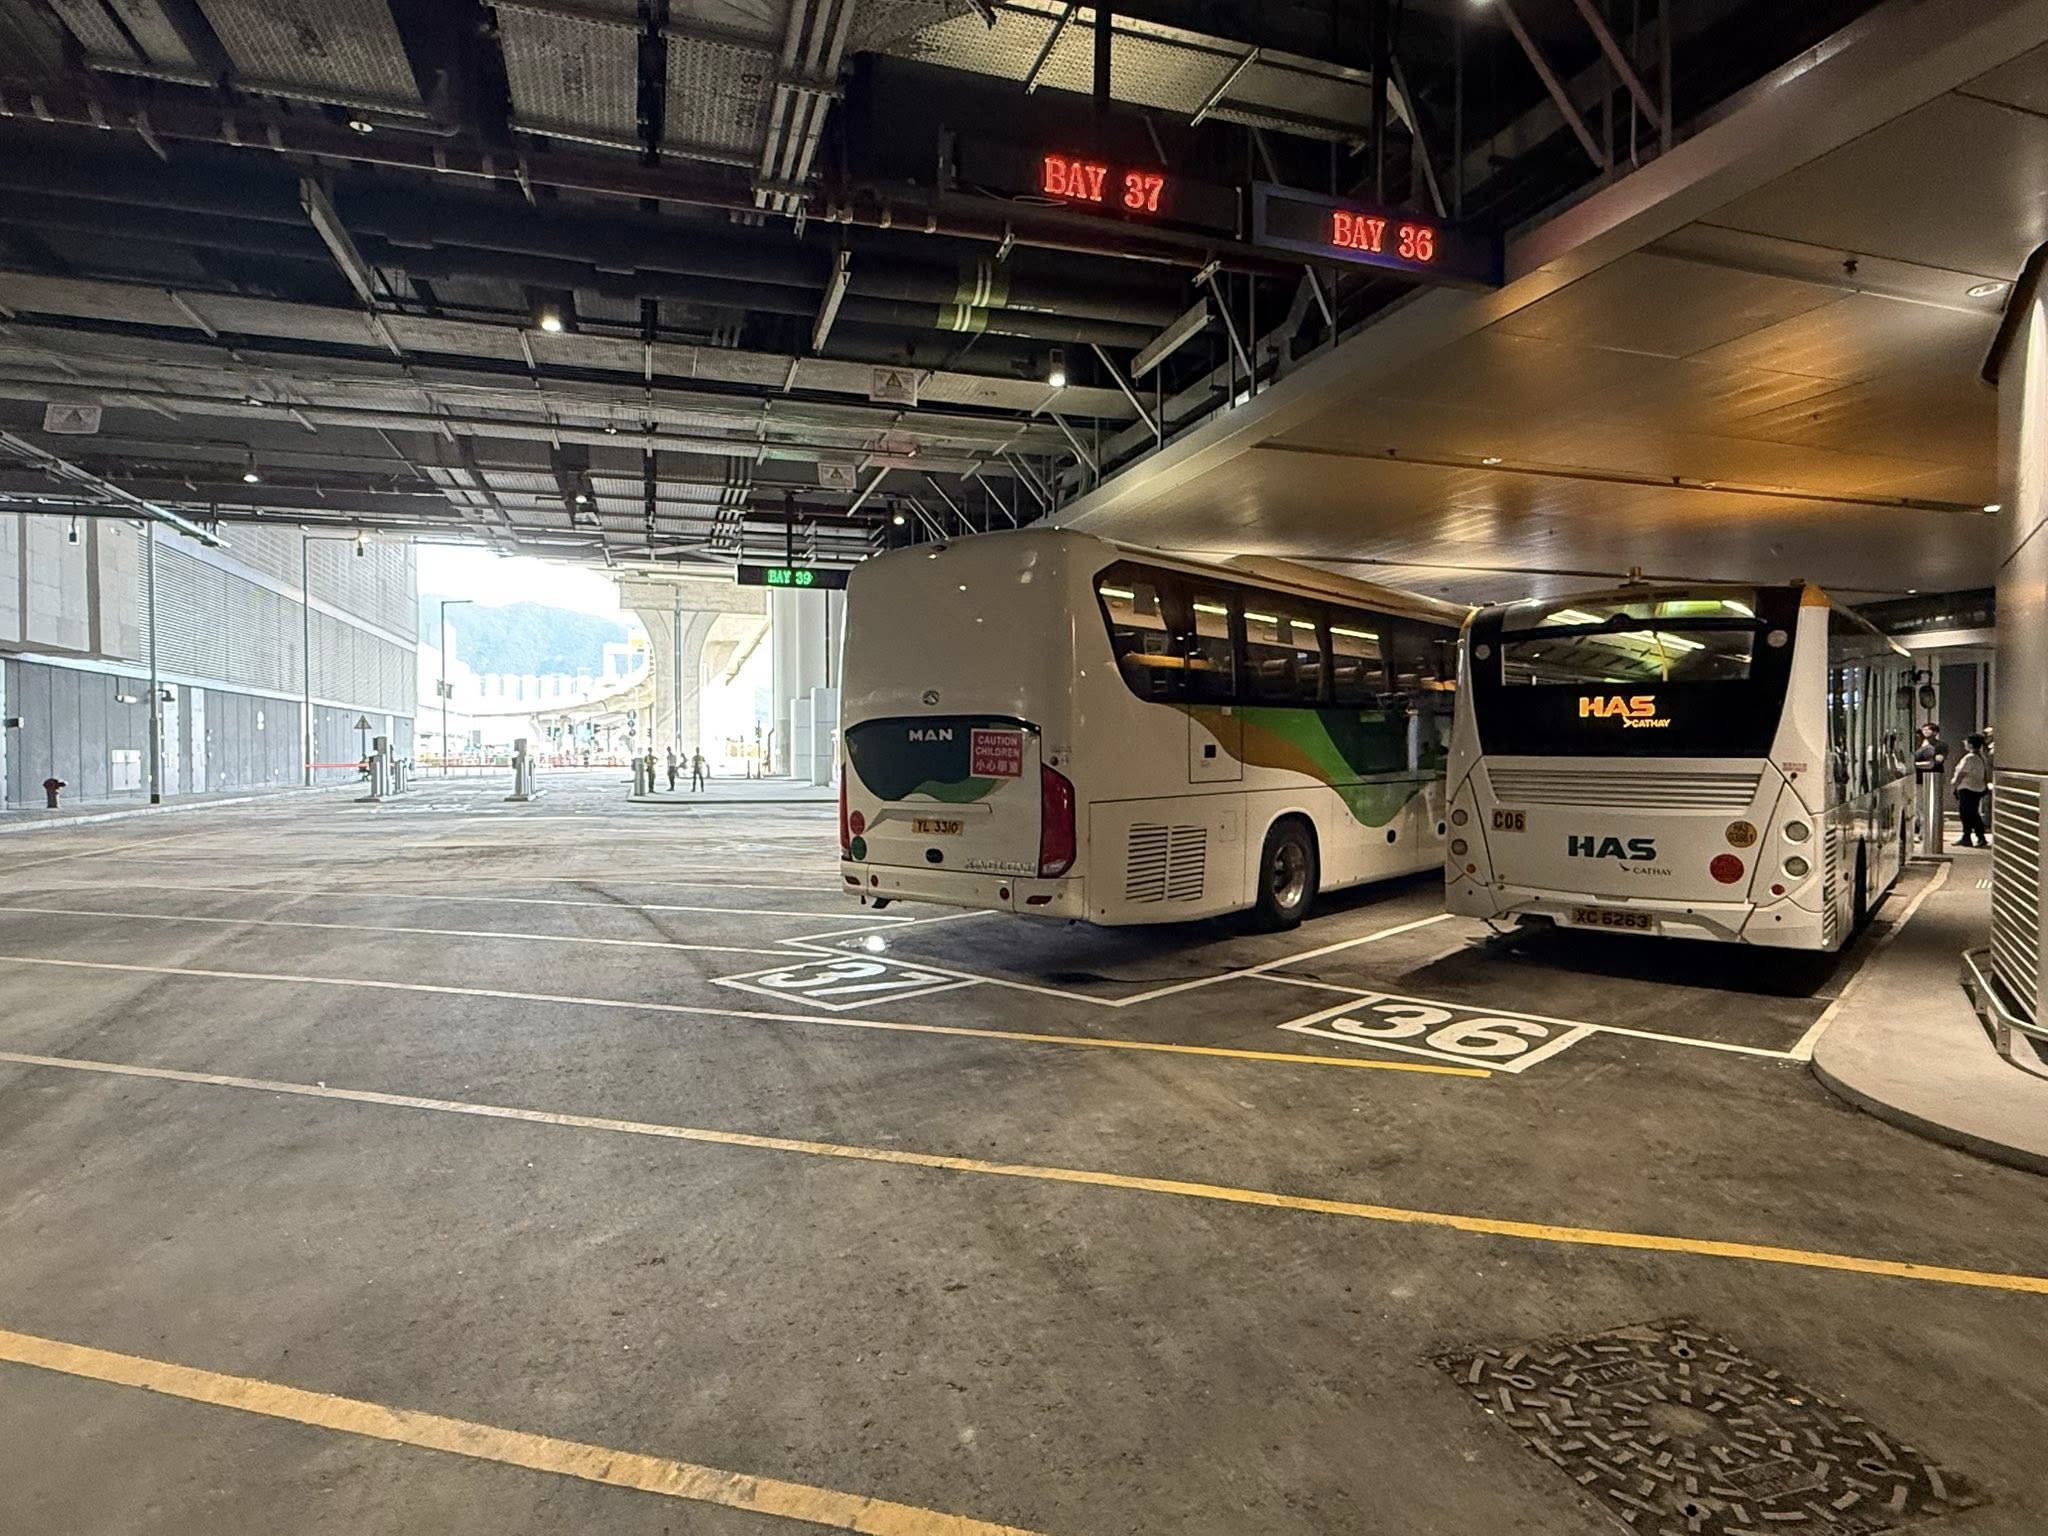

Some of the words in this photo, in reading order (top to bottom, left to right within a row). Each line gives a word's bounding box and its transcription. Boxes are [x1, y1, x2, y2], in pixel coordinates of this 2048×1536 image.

[1044, 156, 1106, 201] BAY
[1124, 173, 1164, 212] 37
[1332, 211, 1386, 253] BAY
[1399, 226, 1434, 262] 36
[767, 569, 792, 584] BAY
[795, 571, 813, 585] 39
[1579, 695, 1656, 717] HAS
[1631, 718, 1671, 728] CATHAY
[908, 728, 953, 742] MAN
[977, 735, 1018, 746] CAUTION
[975, 747, 1020, 758] CHILDREN
[917, 819, 930, 832] YL
[1493, 810, 1524, 830] C06
[1568, 835, 1657, 861] HAS
[1633, 866, 1672, 877] CATHAY
[1576, 910, 1598, 924] XC
[1602, 912, 1648, 929] 6263
[757, 962, 953, 996] 37
[1331, 1004, 1549, 1056] 36
